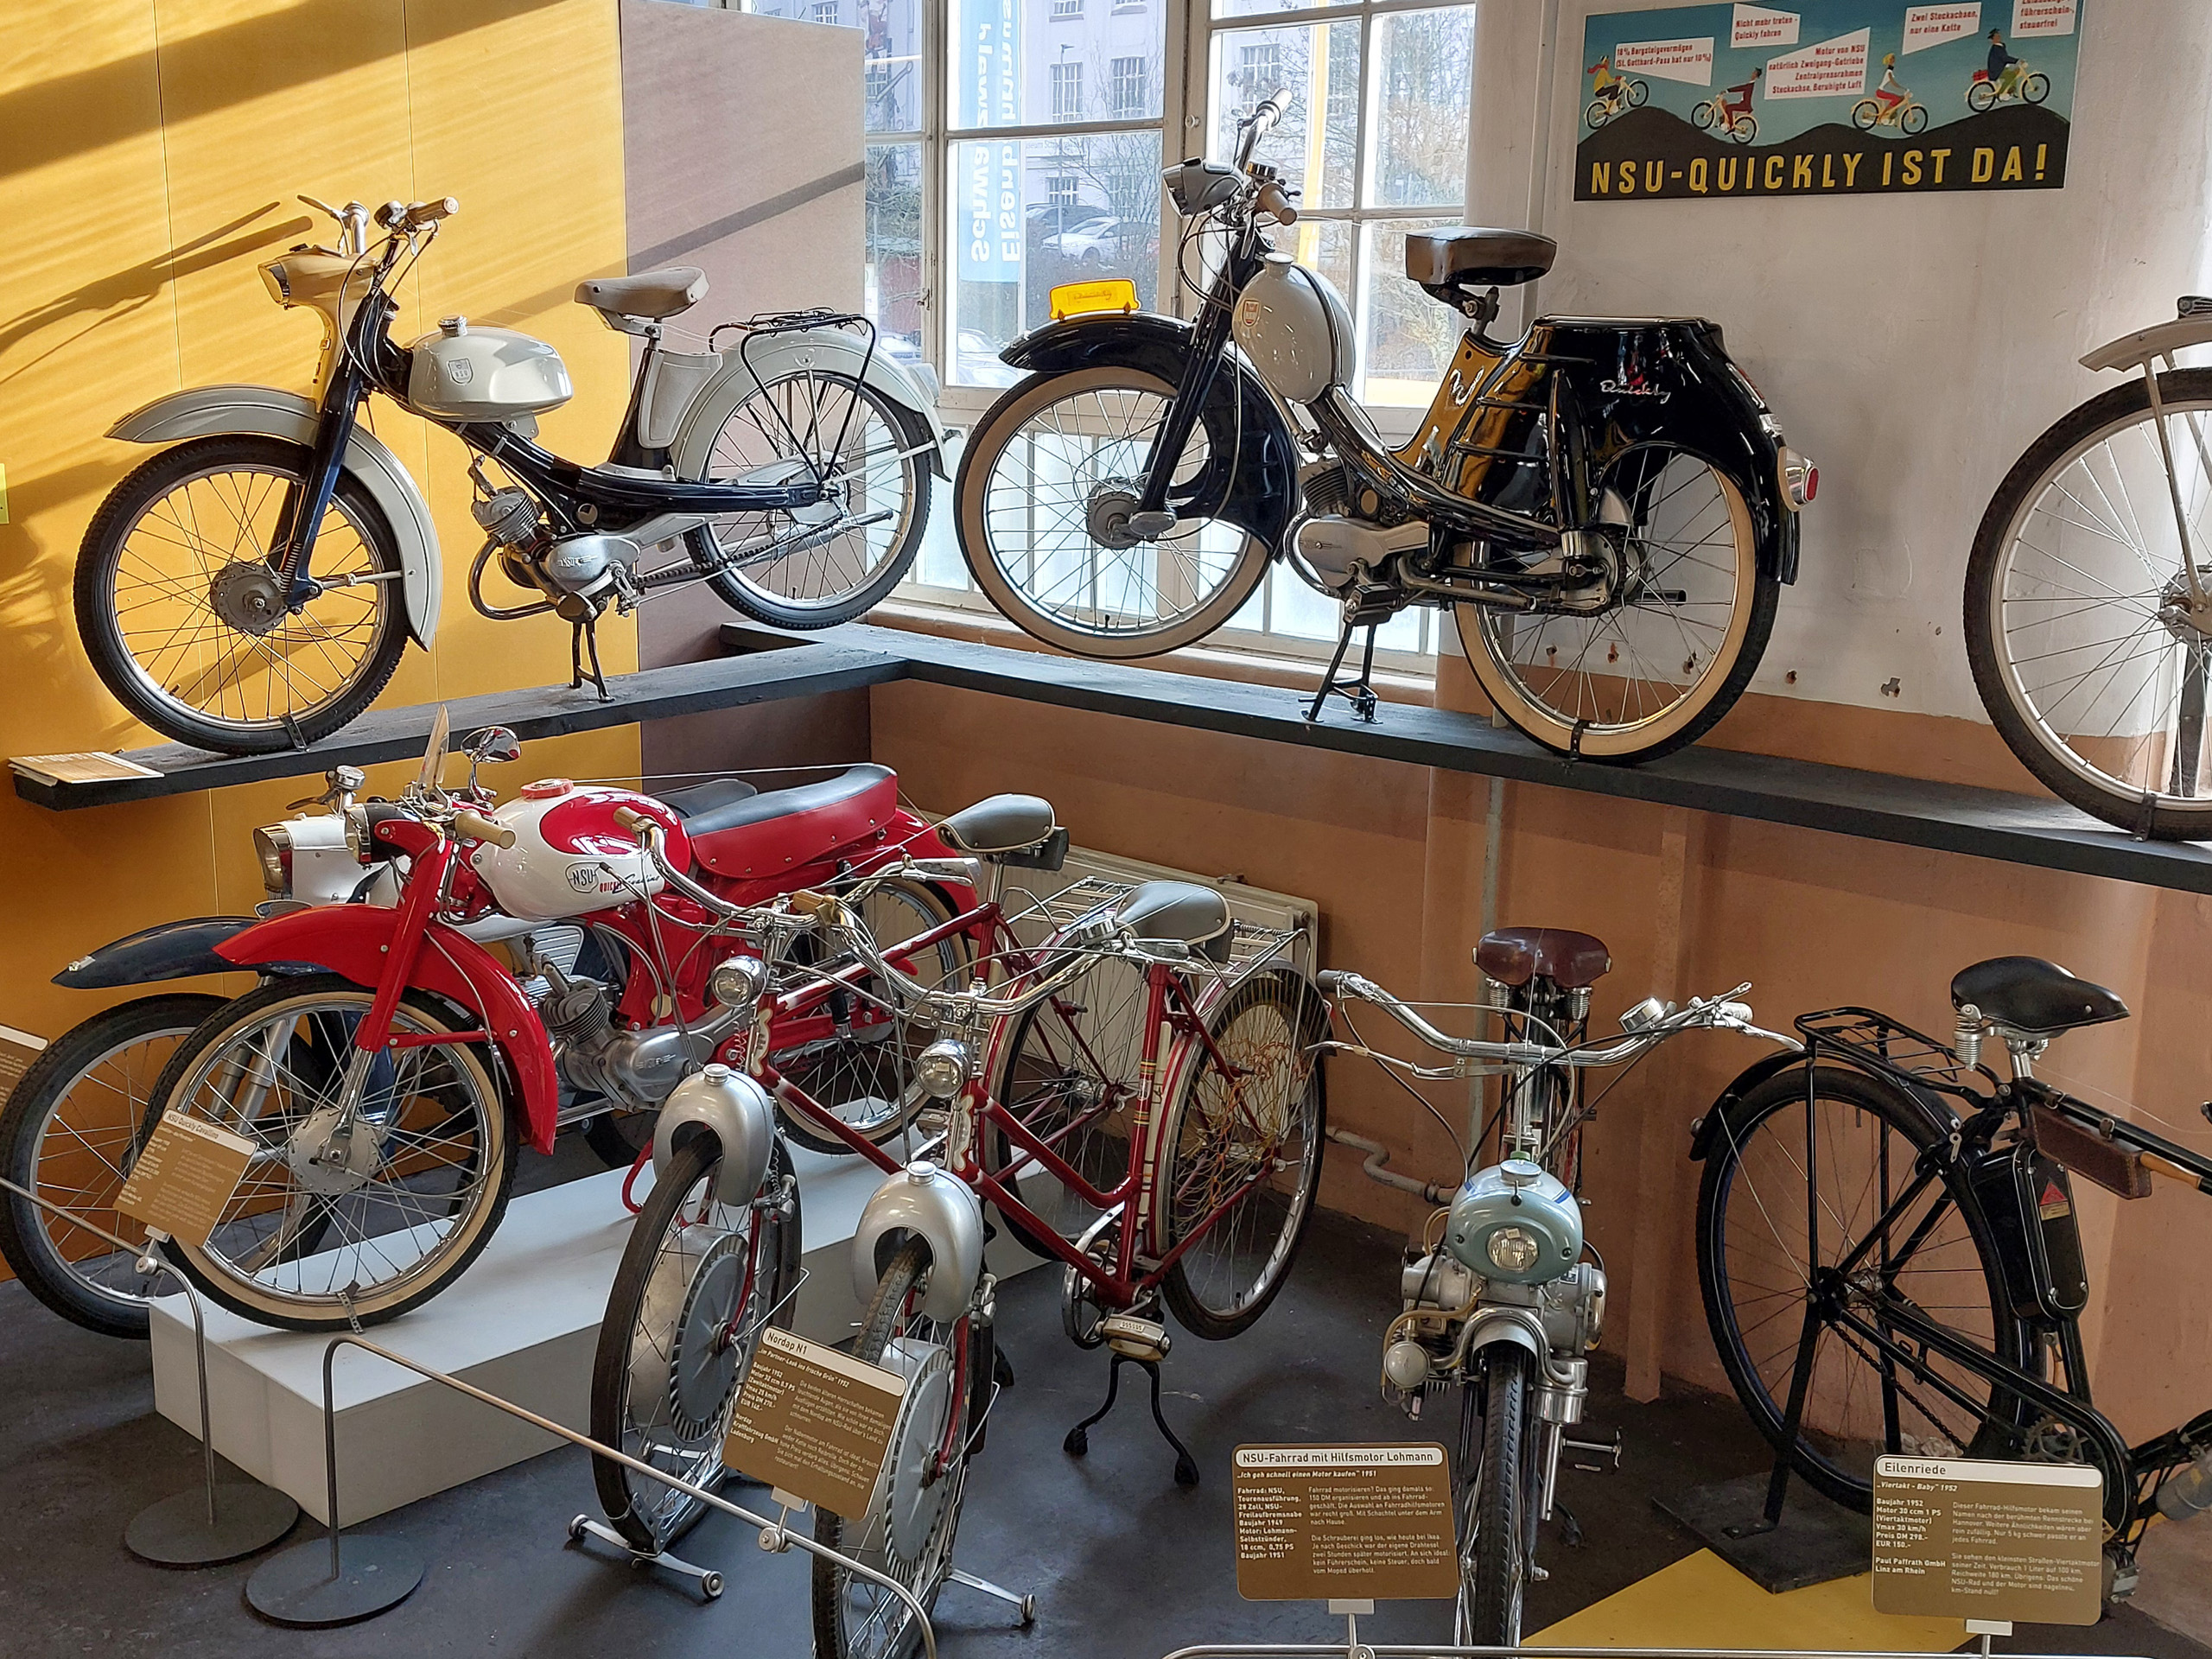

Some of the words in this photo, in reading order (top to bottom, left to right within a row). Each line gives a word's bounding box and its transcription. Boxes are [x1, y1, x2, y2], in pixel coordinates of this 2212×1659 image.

[1911, 13, 1928, 22] Zwei
[1736, 19, 1753, 28] Nicht
[1941, 23, 1961, 32] Kette
[2019, 18, 2057, 29] steuerfrei
[1734, 30, 1759, 41] Quickly
[1815, 47, 1835, 55] Motor
[1850, 44, 1866, 53] NSU
[1627, 56, 1670, 67] Gotthard-Pass
[1671, 55, 1681, 64] hat
[1768, 60, 1799, 70] natürlich
[1801, 57, 1864, 69] Zweigang-Getriebe
[1795, 70, 1863, 80] Zentralpressrahmen
[1847, 80, 1862, 89] Luft
[1591, 152, 1864, 194] NSU-QUICKLY
[1881, 148, 1952, 186] IST
[1971, 143, 2048, 183] DA!
[572, 868, 594, 887] NSU
[766, 1332, 795, 1351] Nordap
[795, 1343, 807, 1354] N1
[1243, 1452, 1308, 1462] NSU-Fahrrad
[1311, 1452, 1328, 1462] mit
[1331, 1452, 1383, 1462] Hilfsmotor
[1386, 1452, 1433, 1461] Lohmann
[1885, 1461, 1945, 1474] Eilenriede
